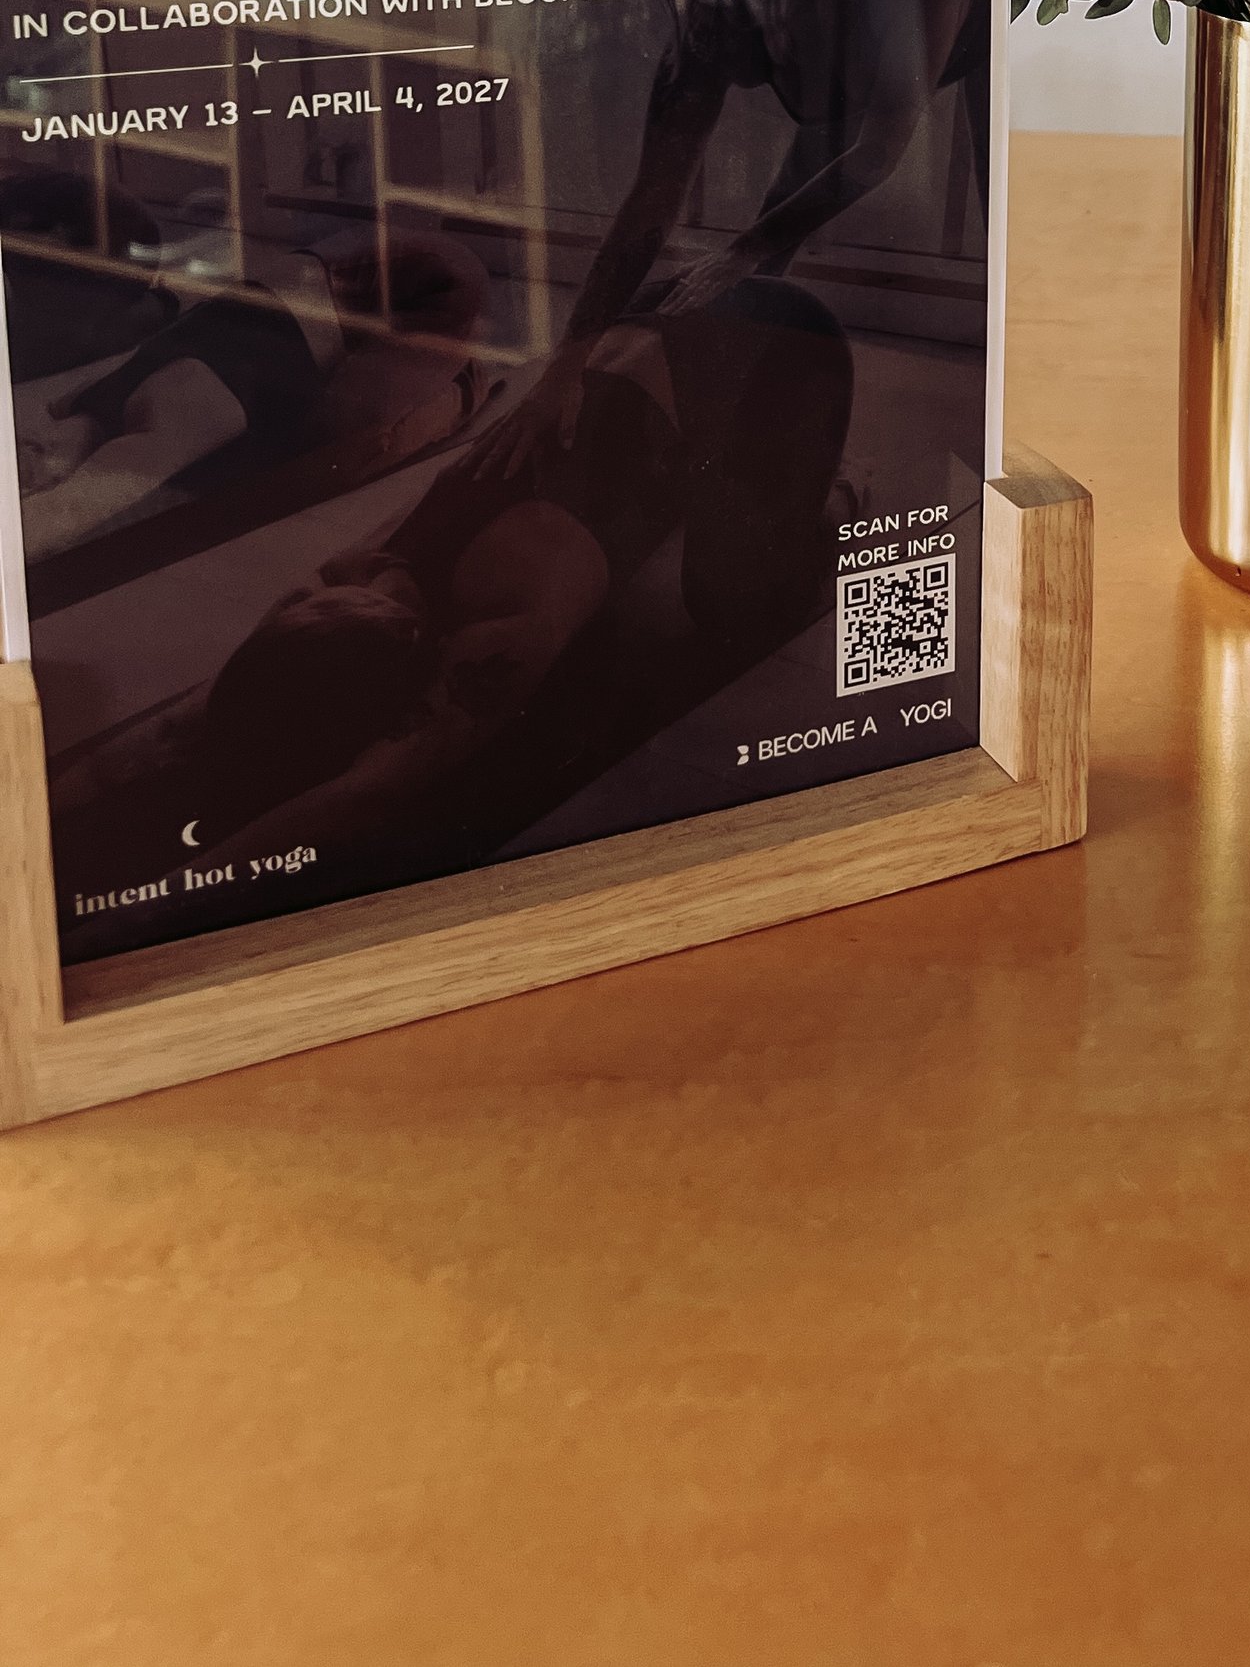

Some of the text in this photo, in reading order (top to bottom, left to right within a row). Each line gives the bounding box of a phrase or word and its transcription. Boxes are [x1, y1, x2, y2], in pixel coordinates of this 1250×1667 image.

[13, 13, 48, 40] IN
[21, 105, 189, 143] JANUARY
[205, 101, 240, 127] 13
[287, 89, 382, 119] APRIL
[395, 85, 424, 113] 4,
[436, 78, 510, 107] 2027
[838, 505, 949, 541] SCAN FOR
[837, 533, 956, 572] MORE INFO
[758, 698, 952, 761] BECOME A YOGI
[75, 845, 318, 916] intent hot yoga
